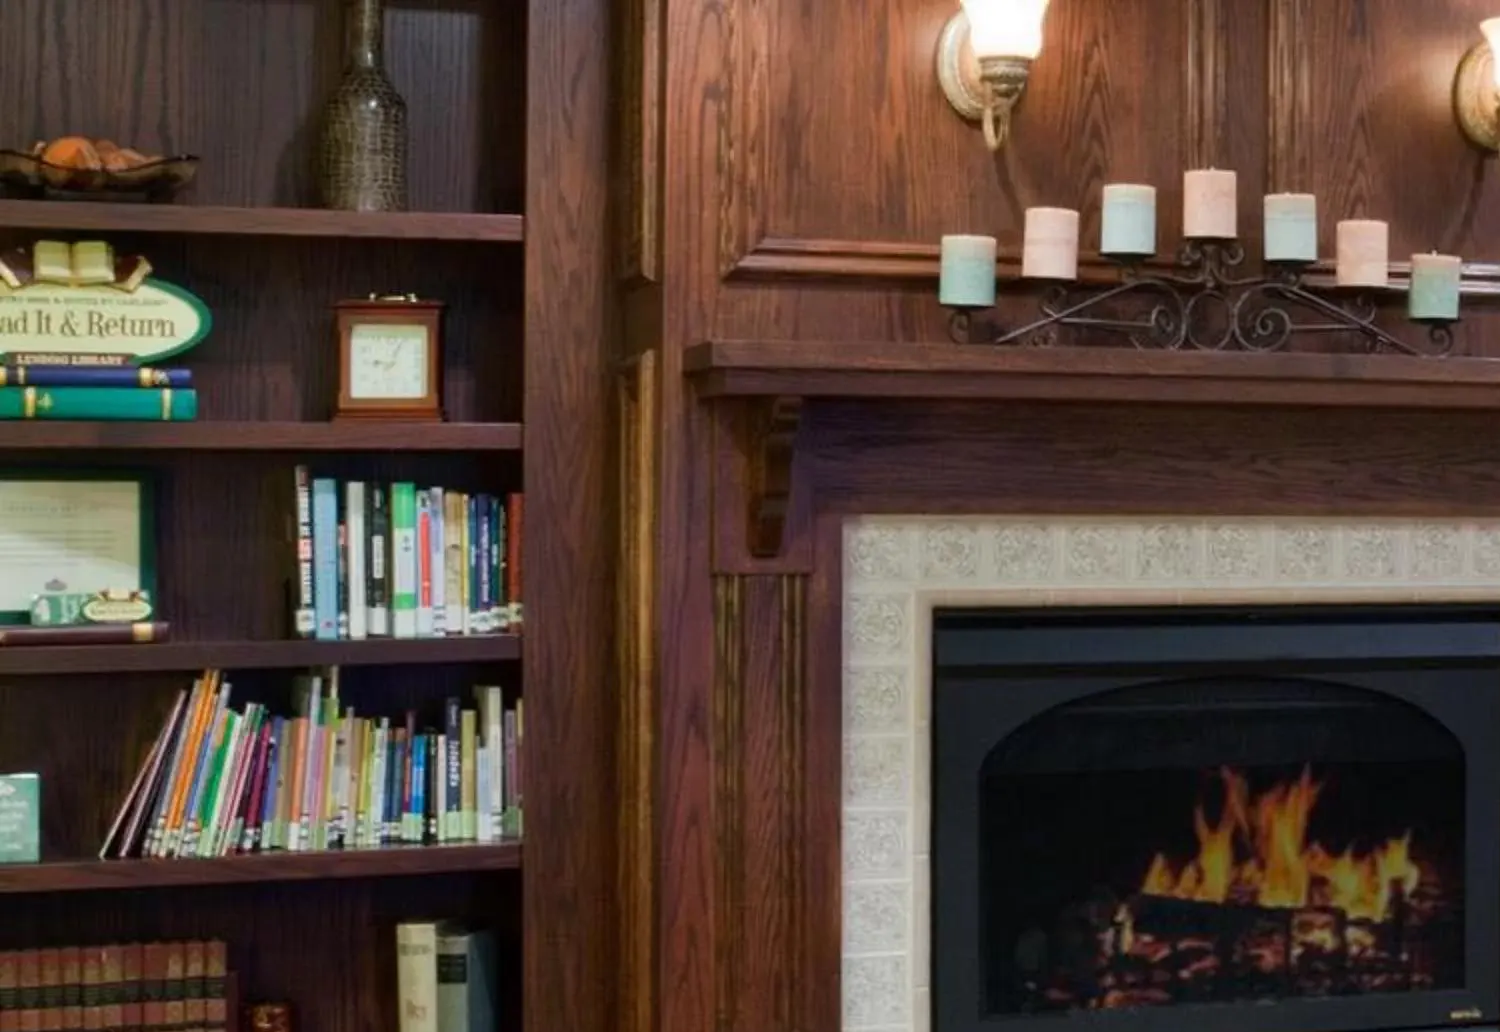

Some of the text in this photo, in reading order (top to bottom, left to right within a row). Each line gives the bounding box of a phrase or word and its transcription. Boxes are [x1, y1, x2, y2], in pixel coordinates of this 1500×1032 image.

[34, 309, 52, 336] It
[60, 309, 80, 337] &
[87, 309, 177, 338] Return
